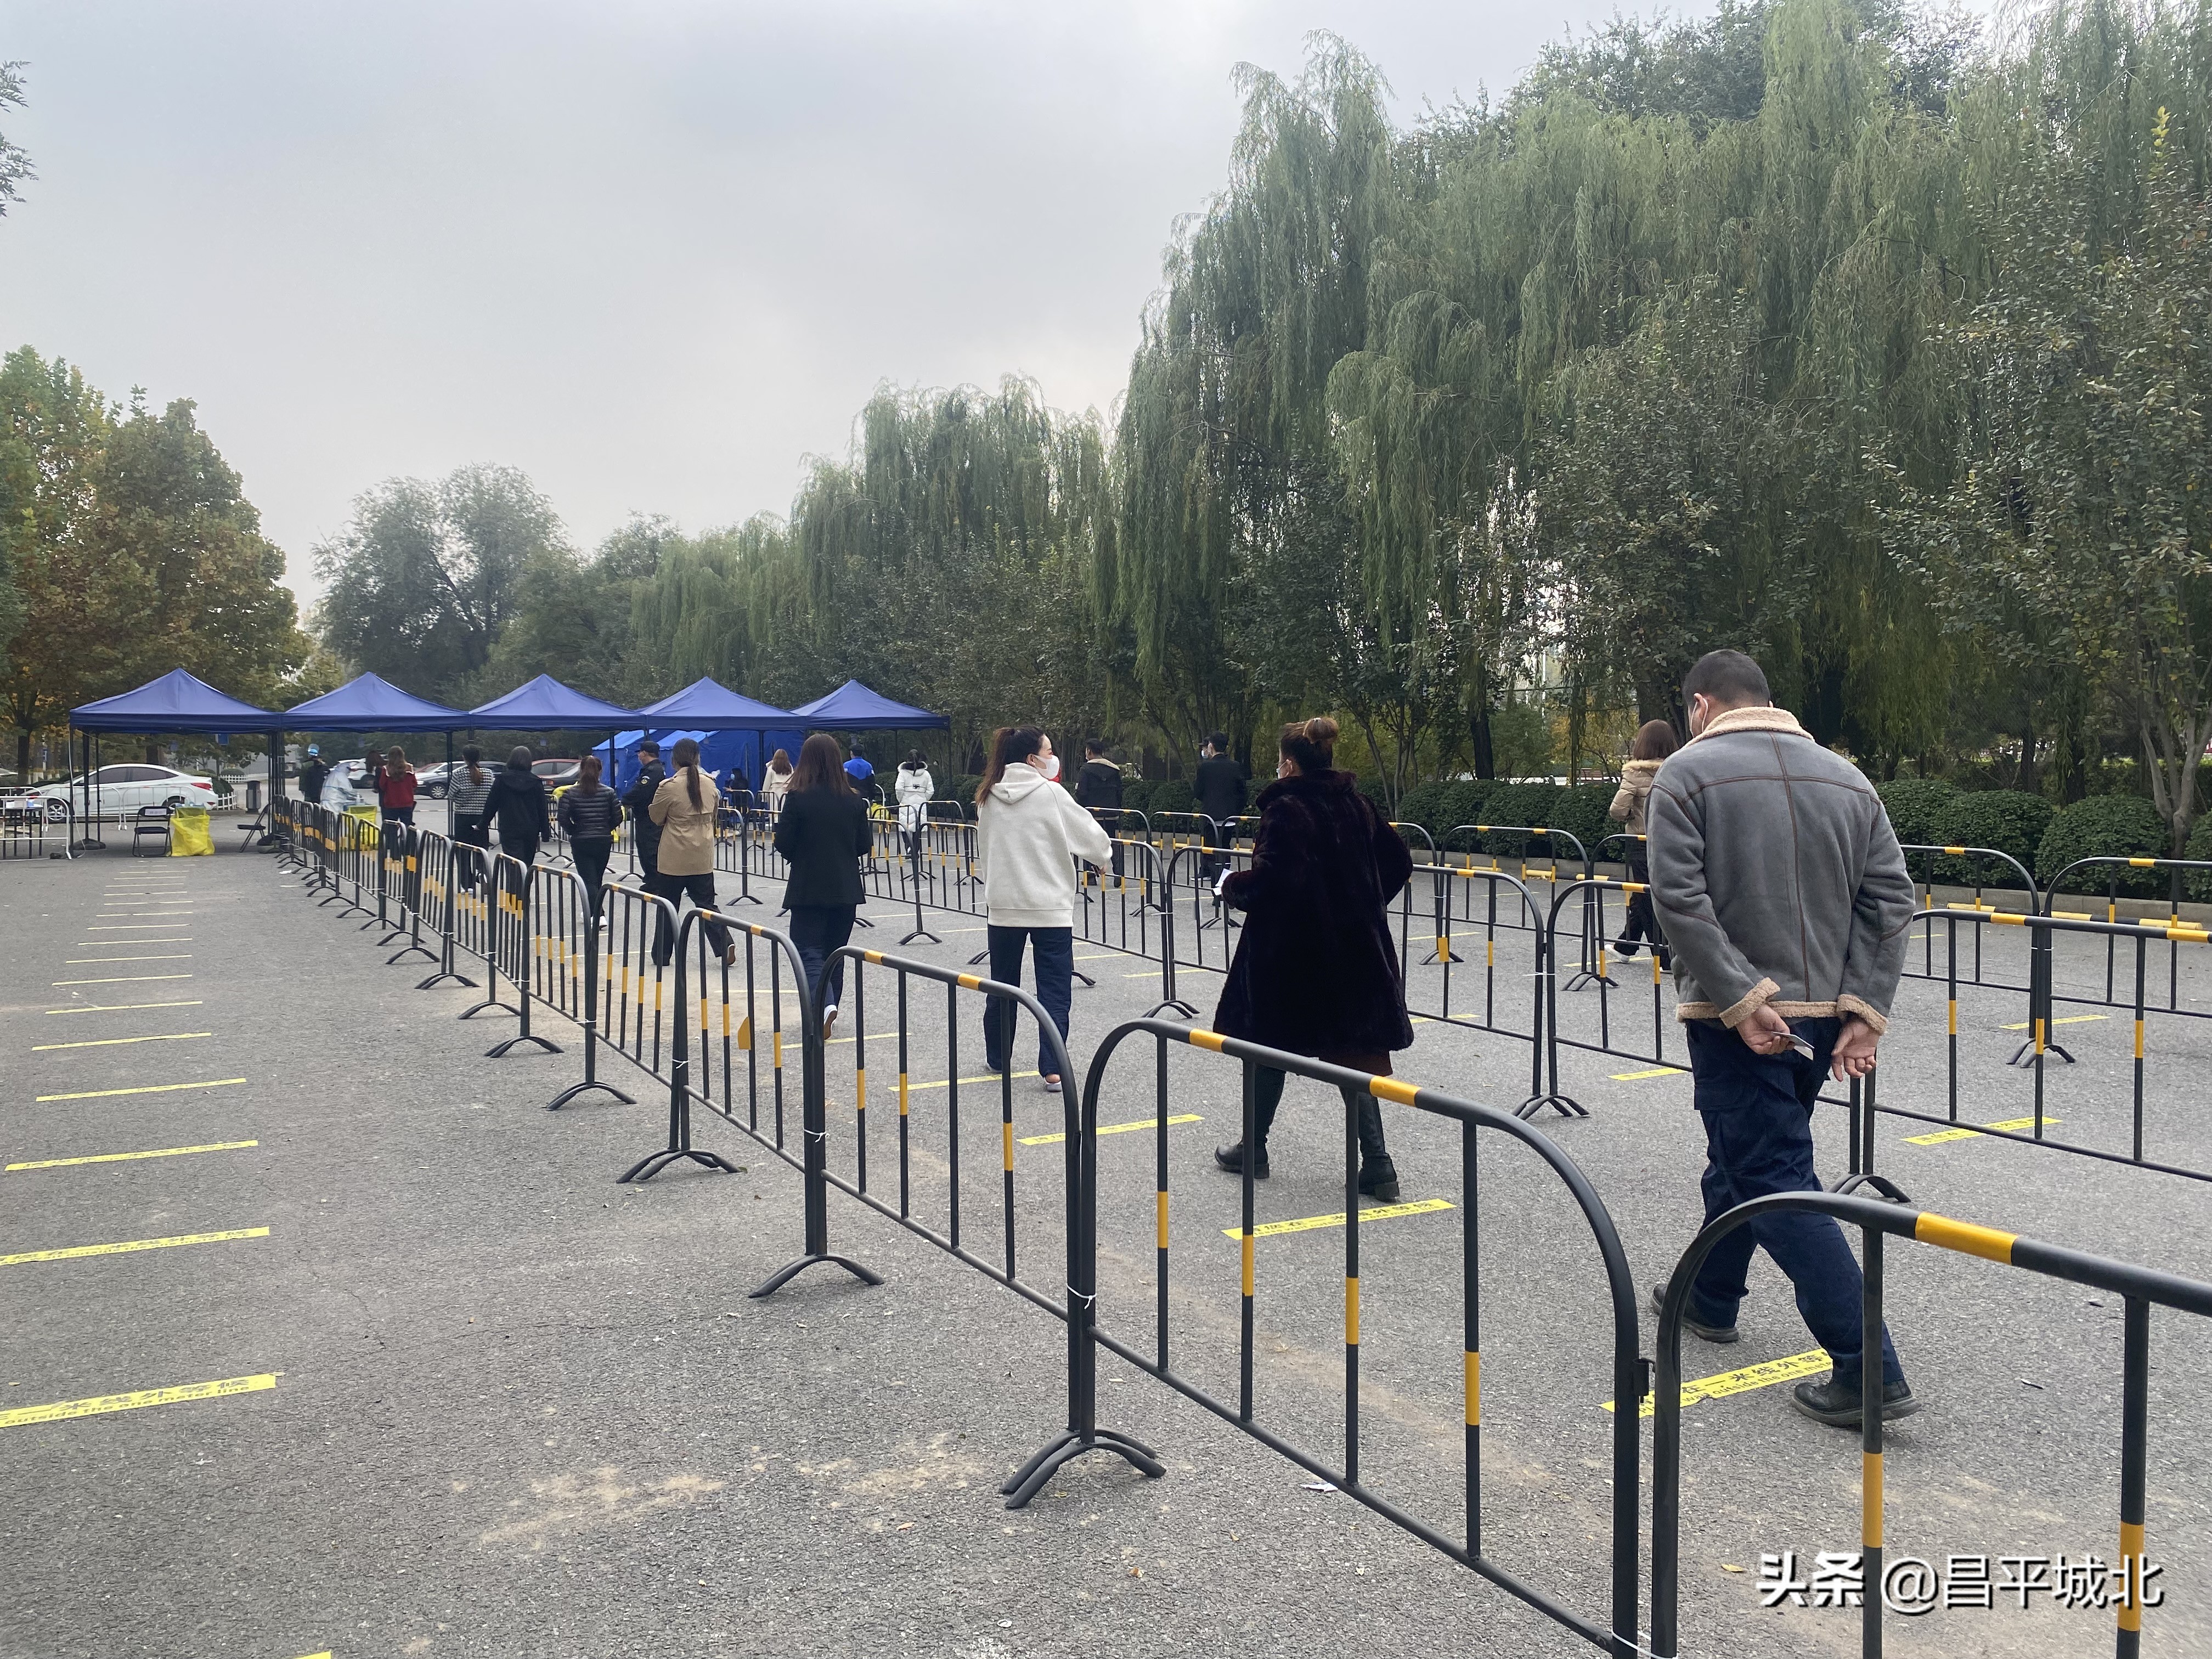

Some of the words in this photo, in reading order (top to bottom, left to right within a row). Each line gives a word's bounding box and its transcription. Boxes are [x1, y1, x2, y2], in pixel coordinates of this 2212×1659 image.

[1712, 1381, 1759, 1395] outside
[1758, 1375, 1780, 1384] the
[1781, 1368, 1804, 1378] one
[1804, 1362, 1832, 1372] mete
[4, 1411, 77, 1425] outside
[119, 1400, 153, 1408] one
[159, 1391, 213, 1402] meter
